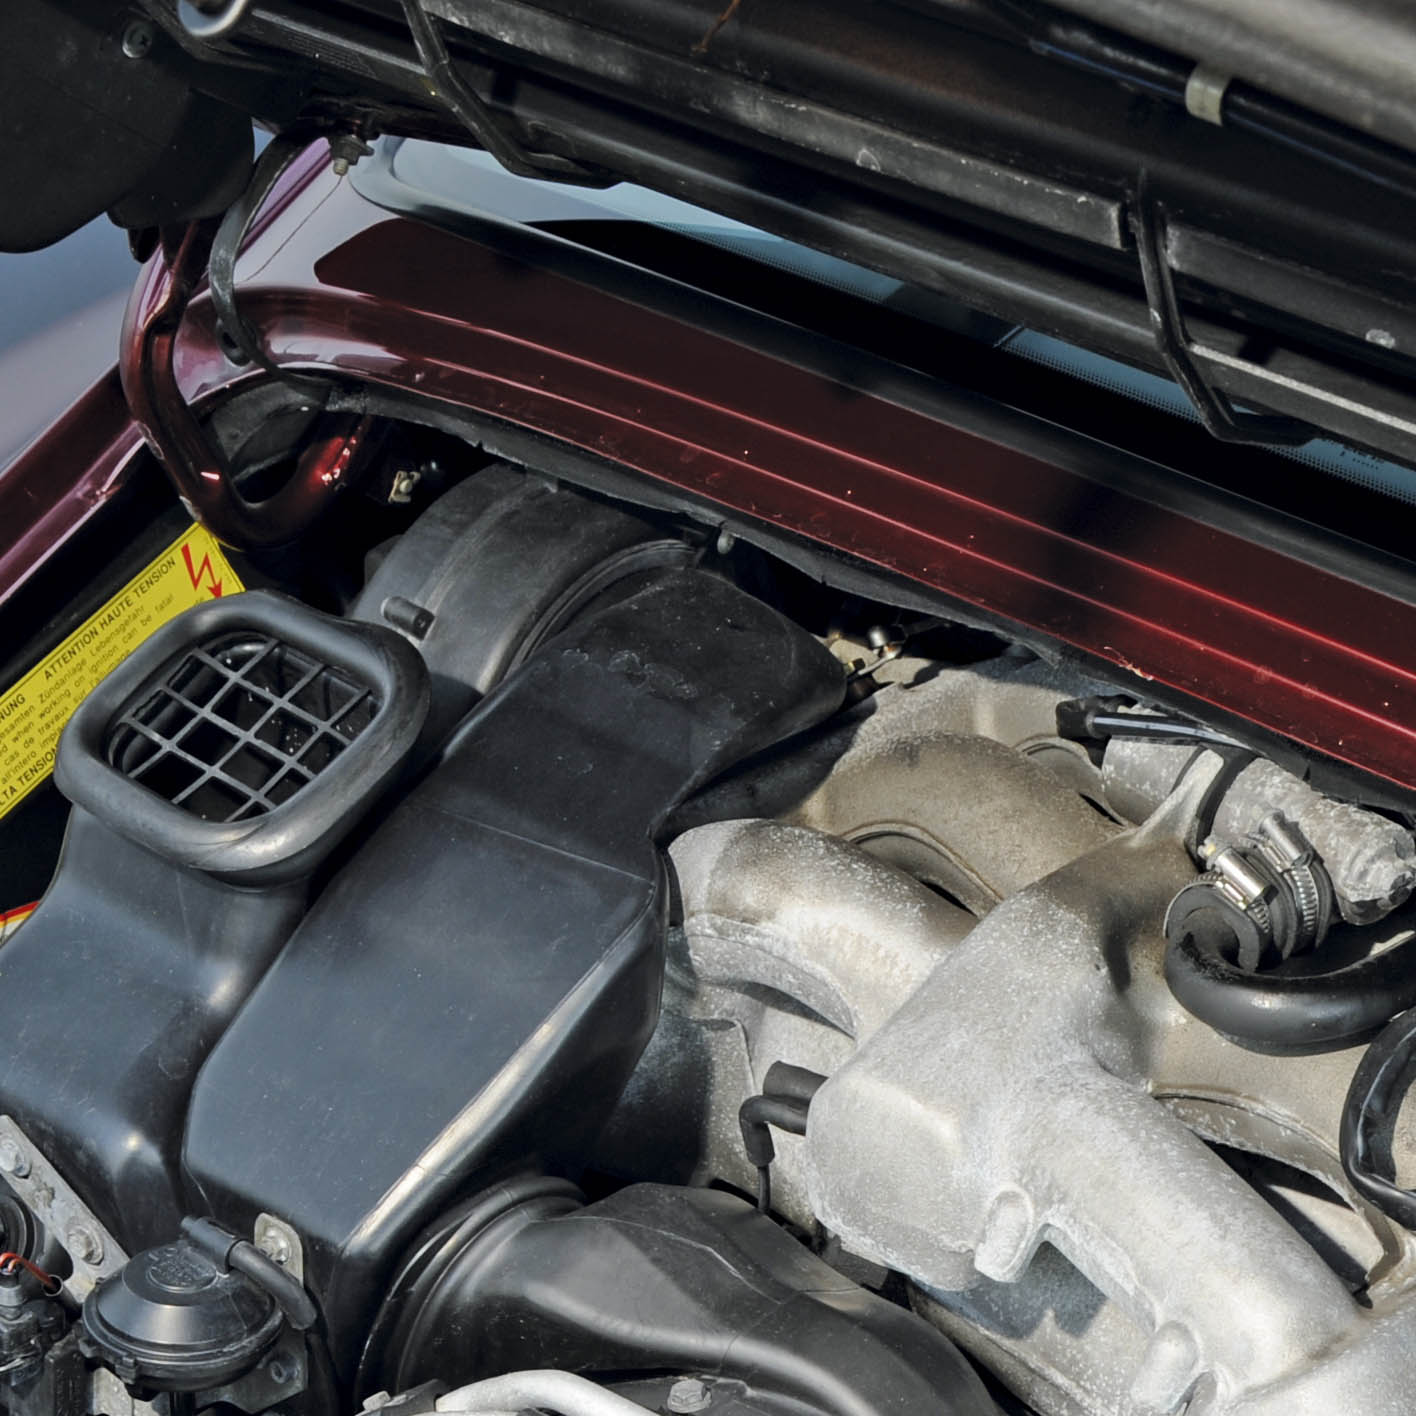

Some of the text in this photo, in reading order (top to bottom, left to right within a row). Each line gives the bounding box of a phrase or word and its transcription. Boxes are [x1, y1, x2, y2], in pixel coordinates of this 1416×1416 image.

[41, 625, 100, 681] ATTENTION
[97, 594, 134, 631] HAUTE
[131, 555, 177, 599] TENSION
